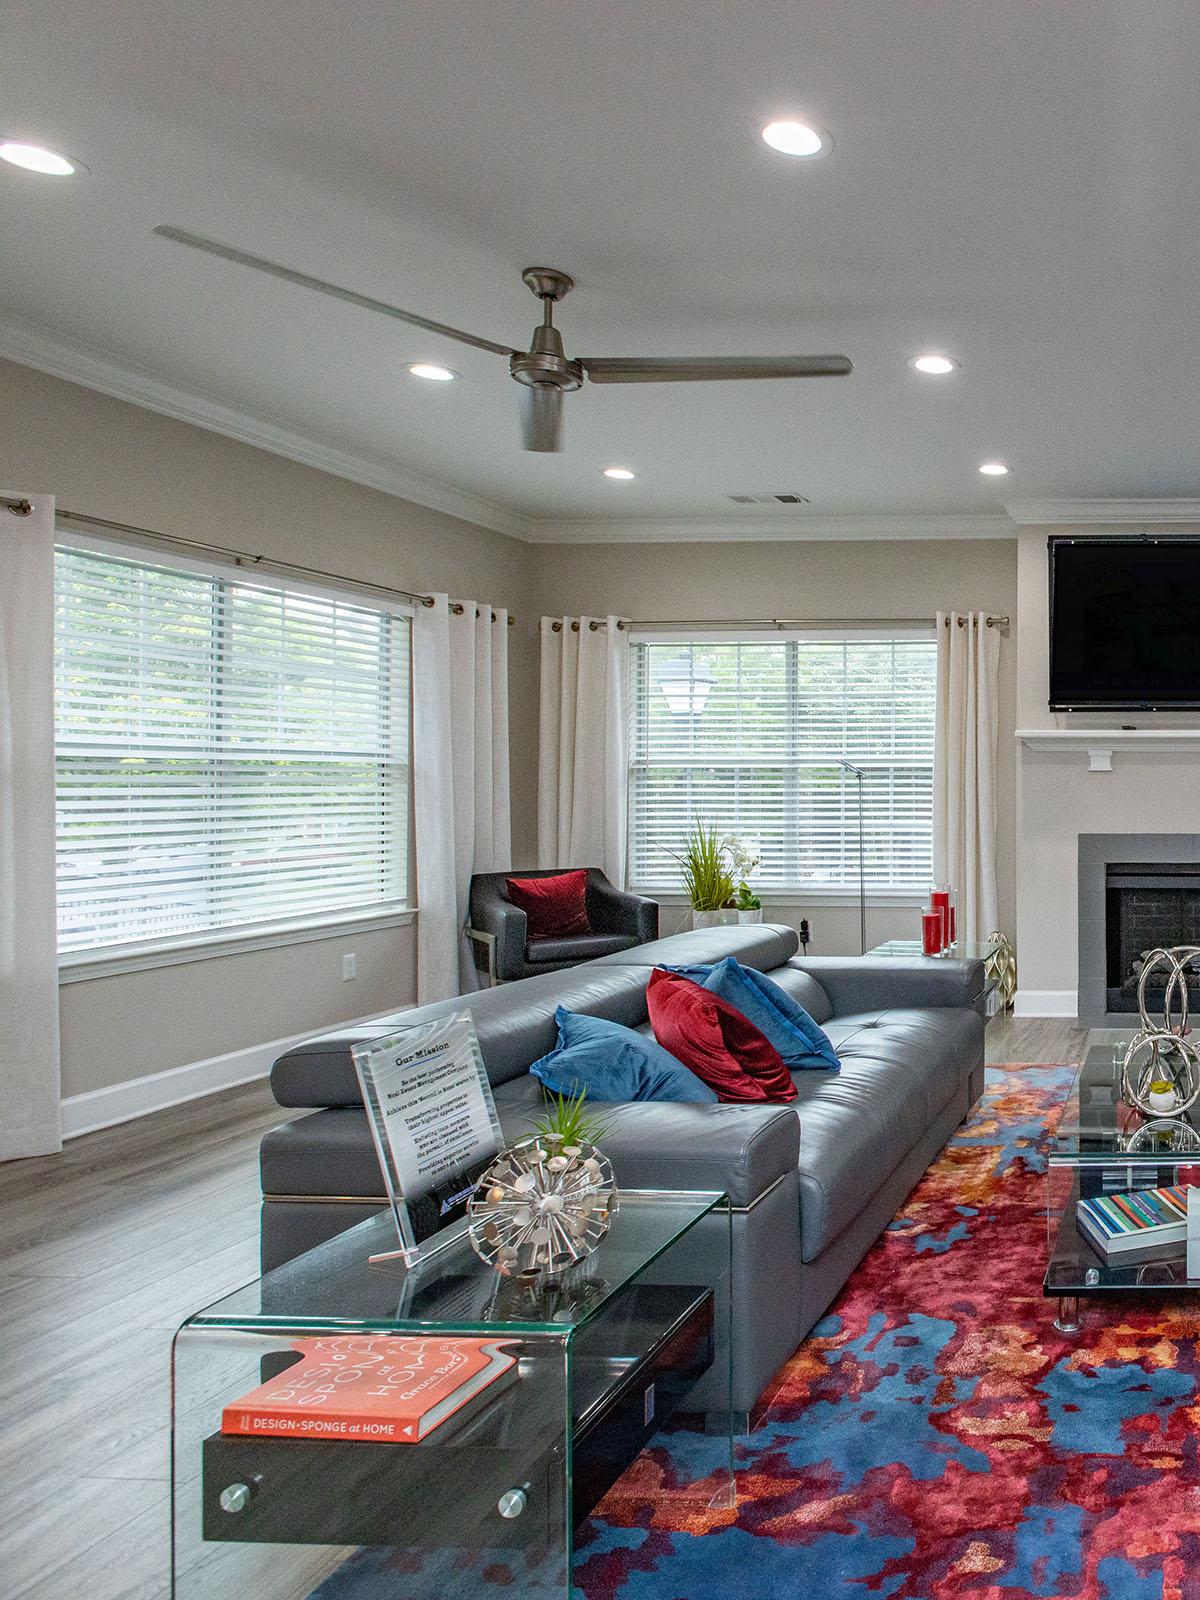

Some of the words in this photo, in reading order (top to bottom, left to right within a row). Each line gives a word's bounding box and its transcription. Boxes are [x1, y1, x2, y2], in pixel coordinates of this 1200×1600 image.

[396, 1054, 414, 1067] Our
[416, 1041, 450, 1059] Mission
[400, 1375, 439, 1401] Grace
[349, 1424, 361, 1433] at
[362, 1424, 395, 1436] HOME
